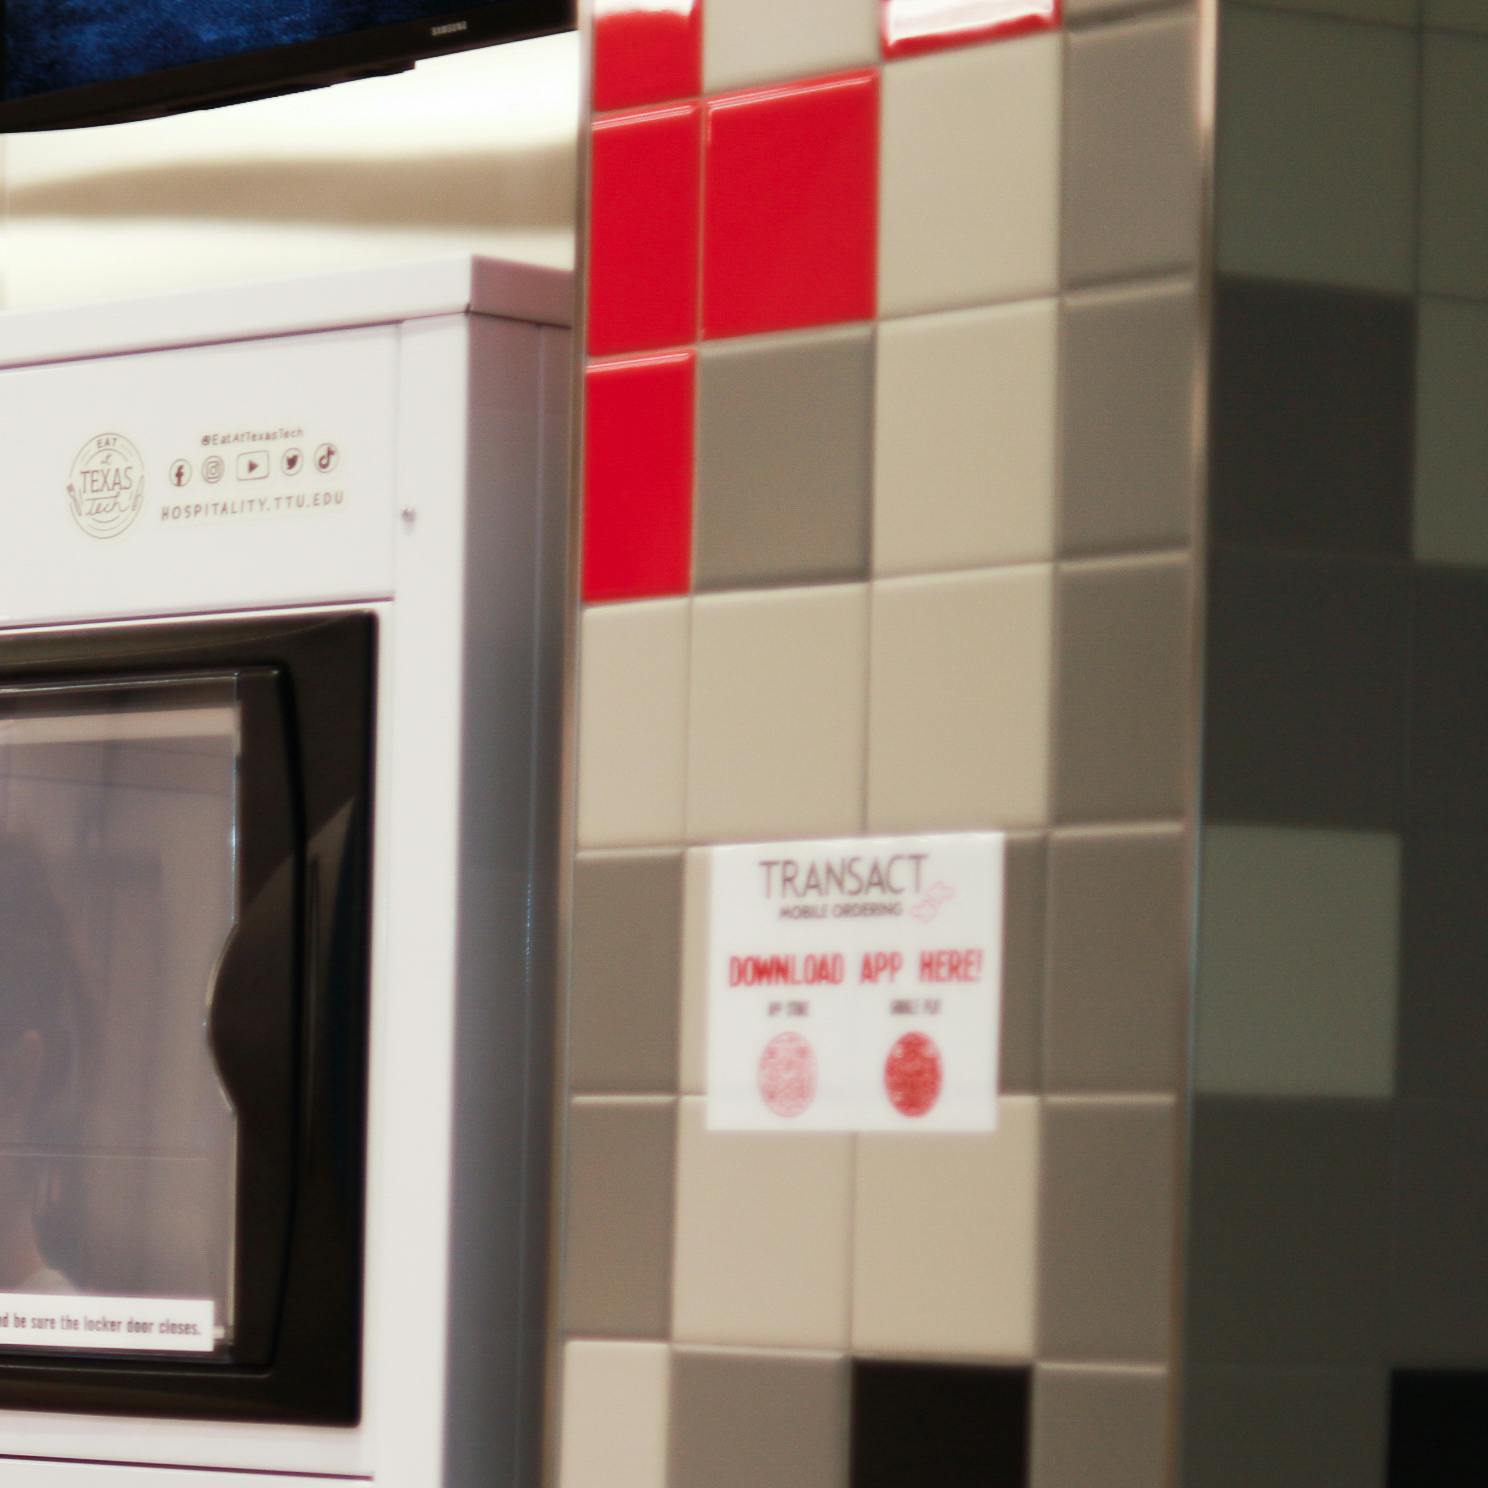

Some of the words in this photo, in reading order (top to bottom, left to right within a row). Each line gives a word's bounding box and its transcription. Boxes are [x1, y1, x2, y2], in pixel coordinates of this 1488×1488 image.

[96, 437, 118, 448] EAT
[80, 465, 133, 494] TEXAS
[162, 490, 345, 521] HOSPITALITY.TTU.EDU
[759, 853, 929, 900] TRANSACT
[779, 904, 828, 921] MOBILE
[832, 902, 904, 920] ORDERING
[729, 953, 845, 988] DOWNLOAD
[858, 951, 903, 985] APP
[919, 949, 984, 983] HERE!
[13, 1312, 27, 1329] be
[31, 1316, 56, 1330] sure
[60, 1314, 80, 1331] the
[84, 1315, 122, 1333] locker
[126, 1317, 153, 1334] door
[159, 1319, 202, 1336] closes.
